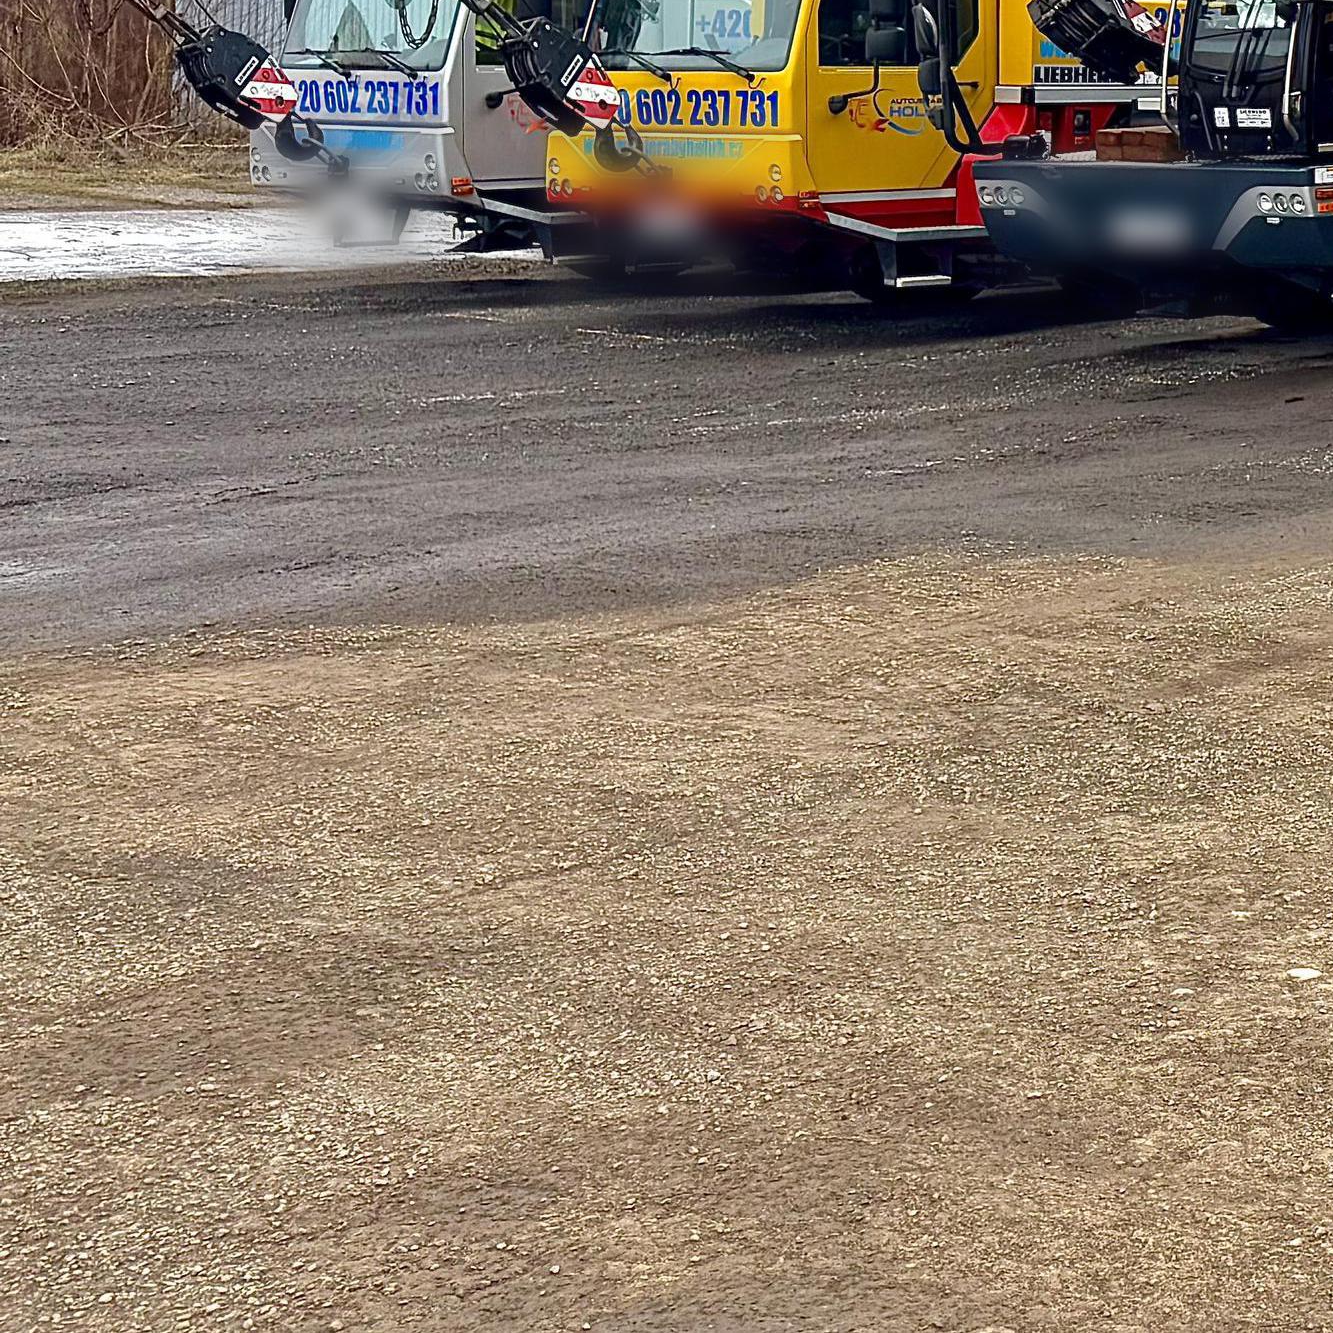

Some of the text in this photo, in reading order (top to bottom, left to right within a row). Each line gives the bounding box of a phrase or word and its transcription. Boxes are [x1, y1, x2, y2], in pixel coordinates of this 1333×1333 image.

[1034, 67, 1112, 84] LIEBHE
[324, 80, 361, 114] 602
[365, 80, 399, 116] 237
[403, 80, 439, 116] 731
[636, 89, 684, 126] 602
[687, 90, 731, 126] 237
[736, 90, 779, 127] 731
[890, 106, 926, 117] HOL
